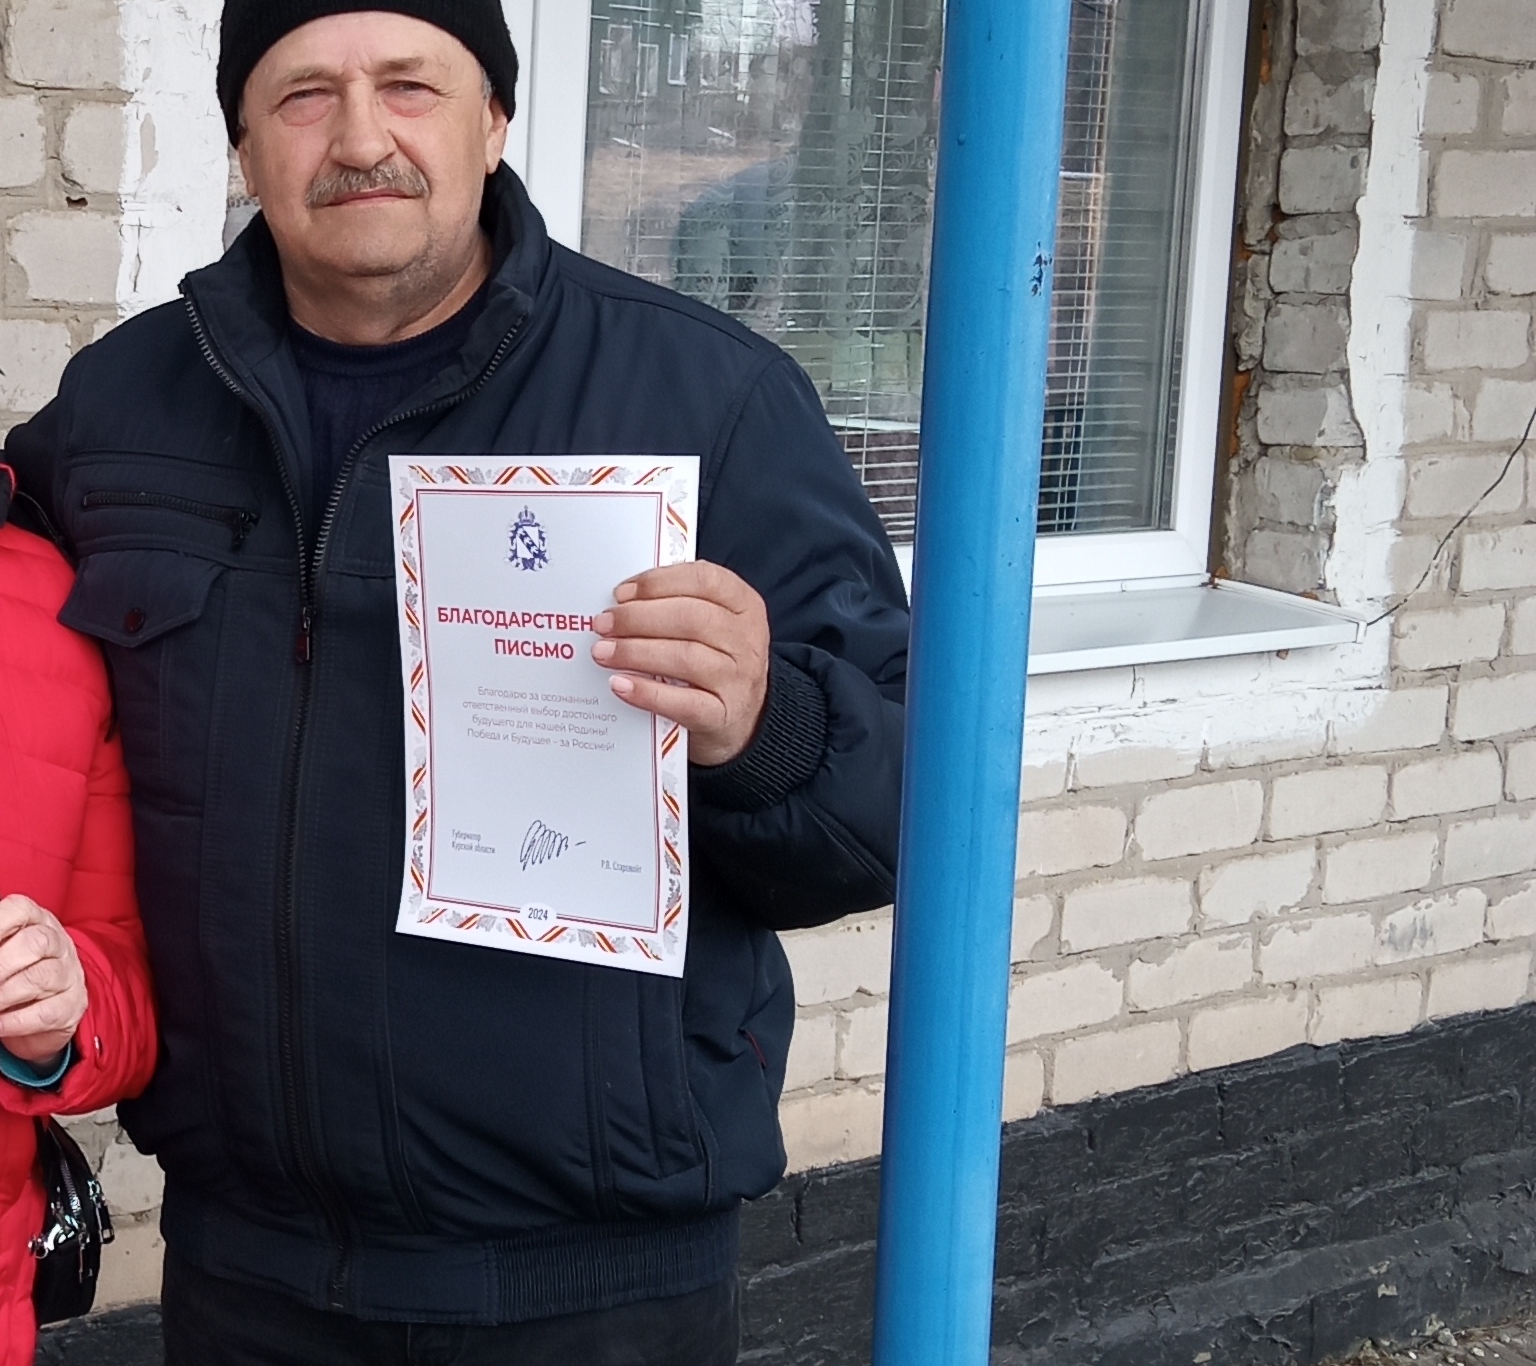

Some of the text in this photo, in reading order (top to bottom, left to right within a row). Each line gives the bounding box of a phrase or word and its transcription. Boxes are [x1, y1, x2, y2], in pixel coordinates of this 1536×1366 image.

[437, 606, 594, 631] БЛАГОДАРСТВЕН
[495, 639, 574, 660] ПИСЬМО
[478, 686, 599, 705] Благодарю за осознанный
[472, 714, 514, 727] будущего
[516, 720, 533, 729] для
[535, 723, 566, 732] нашей
[530, 706, 560, 718] выбор
[562, 711, 617, 722] достойного
[467, 728, 500, 741] Победа
[560, 739, 570, 747] за
[528, 907, 548, 921] 2024
